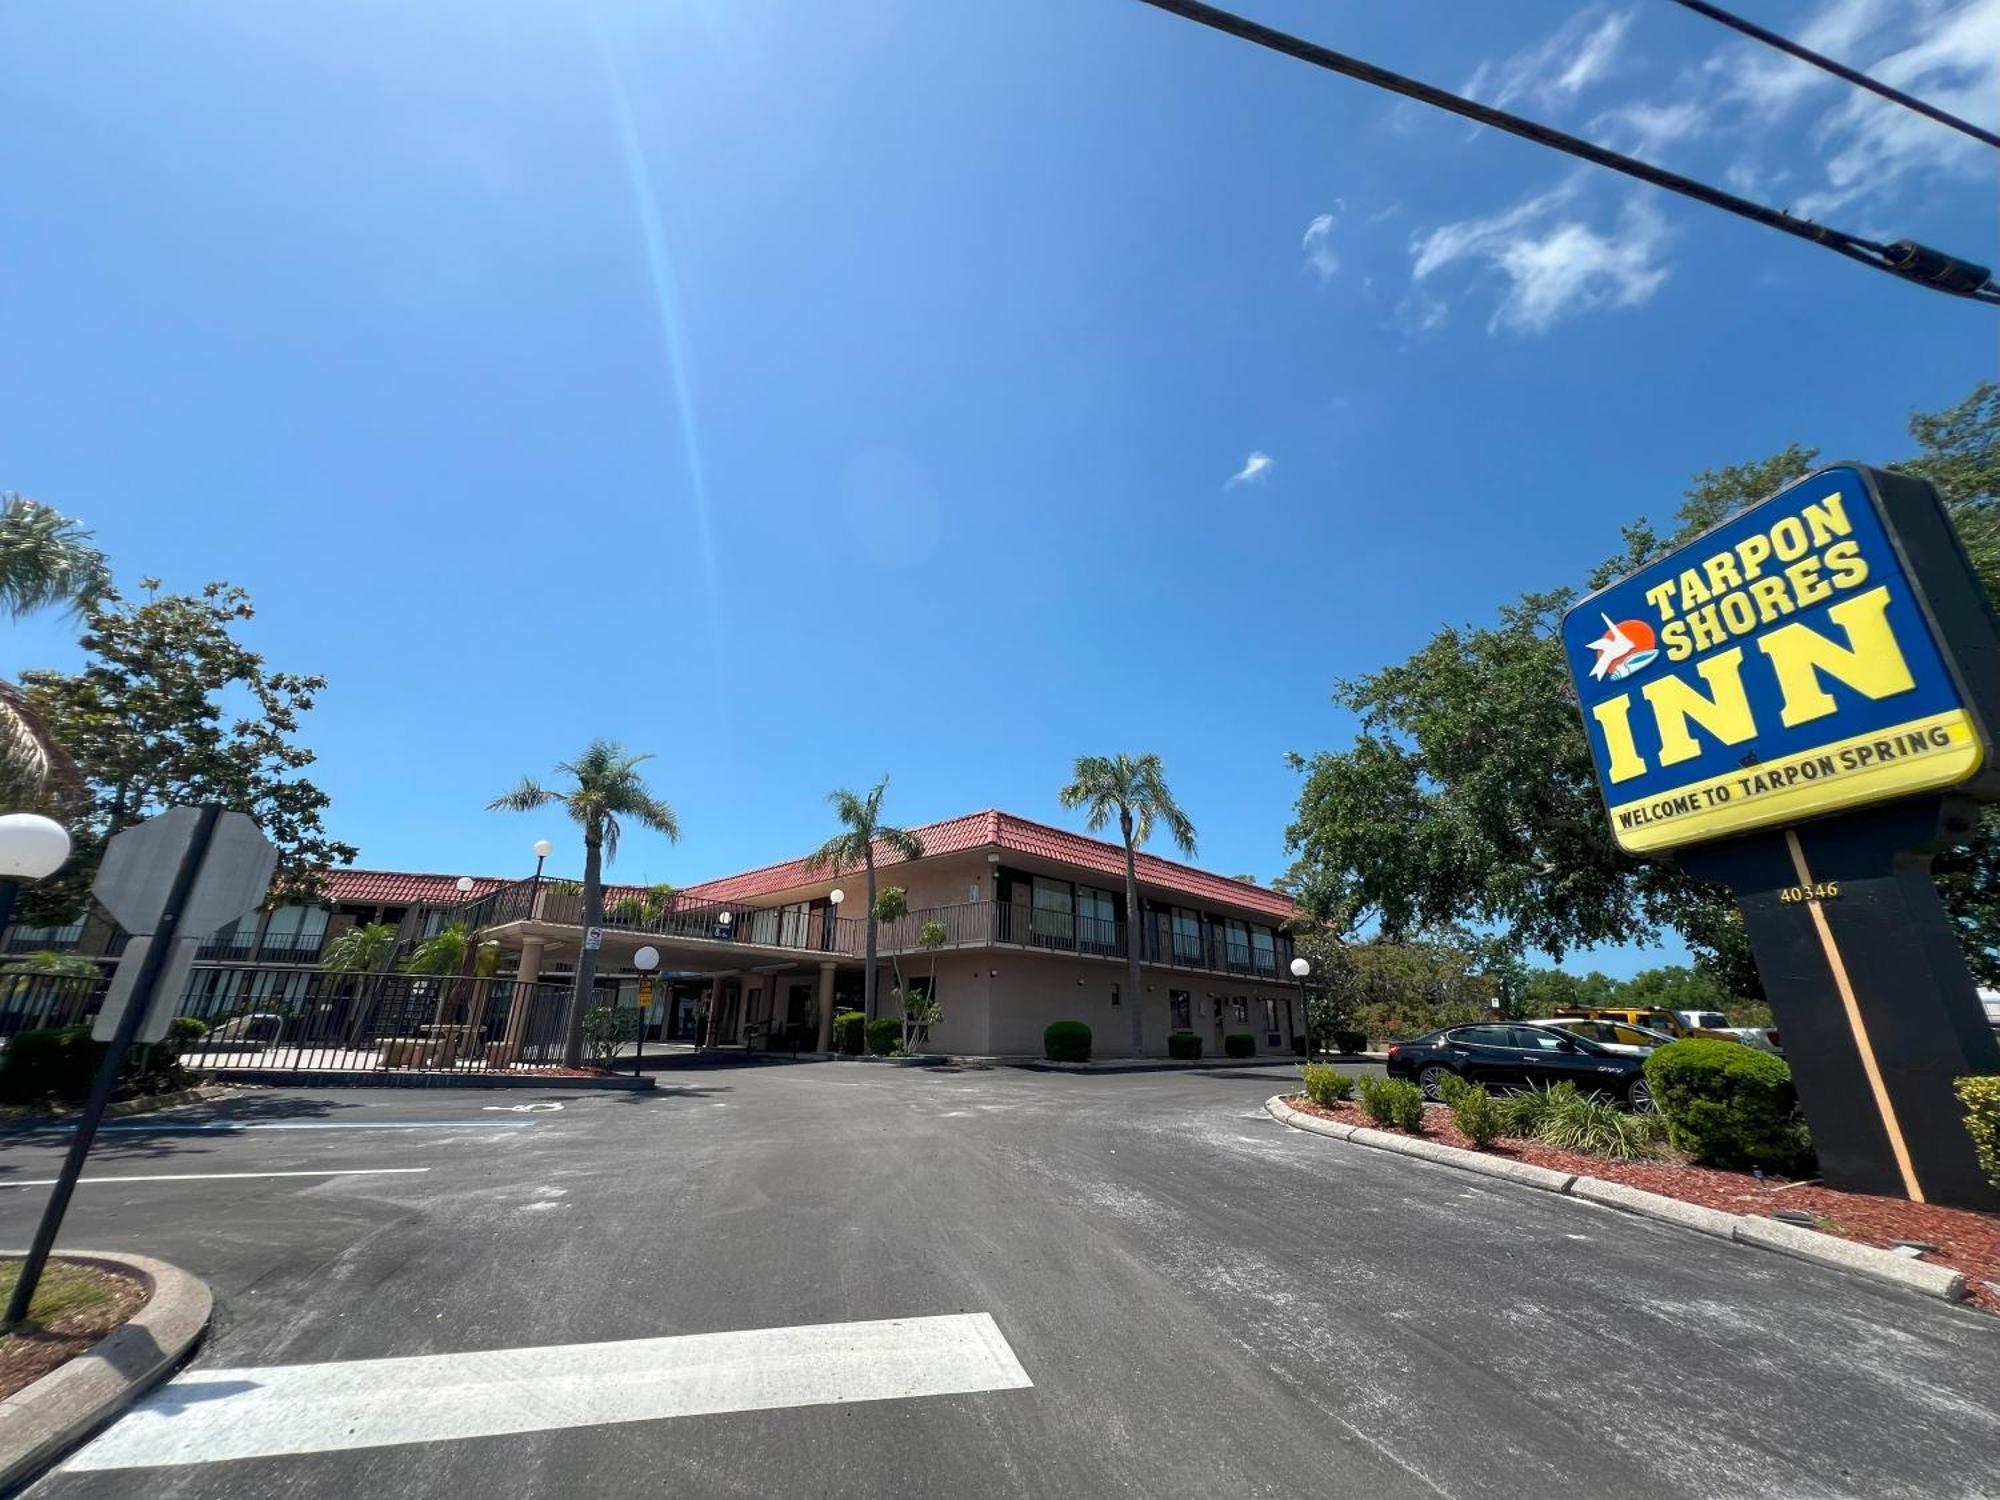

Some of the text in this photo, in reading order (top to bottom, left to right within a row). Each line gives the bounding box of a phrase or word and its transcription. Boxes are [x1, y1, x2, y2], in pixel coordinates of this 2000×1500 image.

[1645, 491, 1853, 621] TARPON
[1661, 540, 1869, 661] SHORES
[1593, 585, 1916, 784] INN
[1619, 726, 1950, 829] WELCOME TO TARPON SPRING
[1781, 881, 1840, 902] 40346
